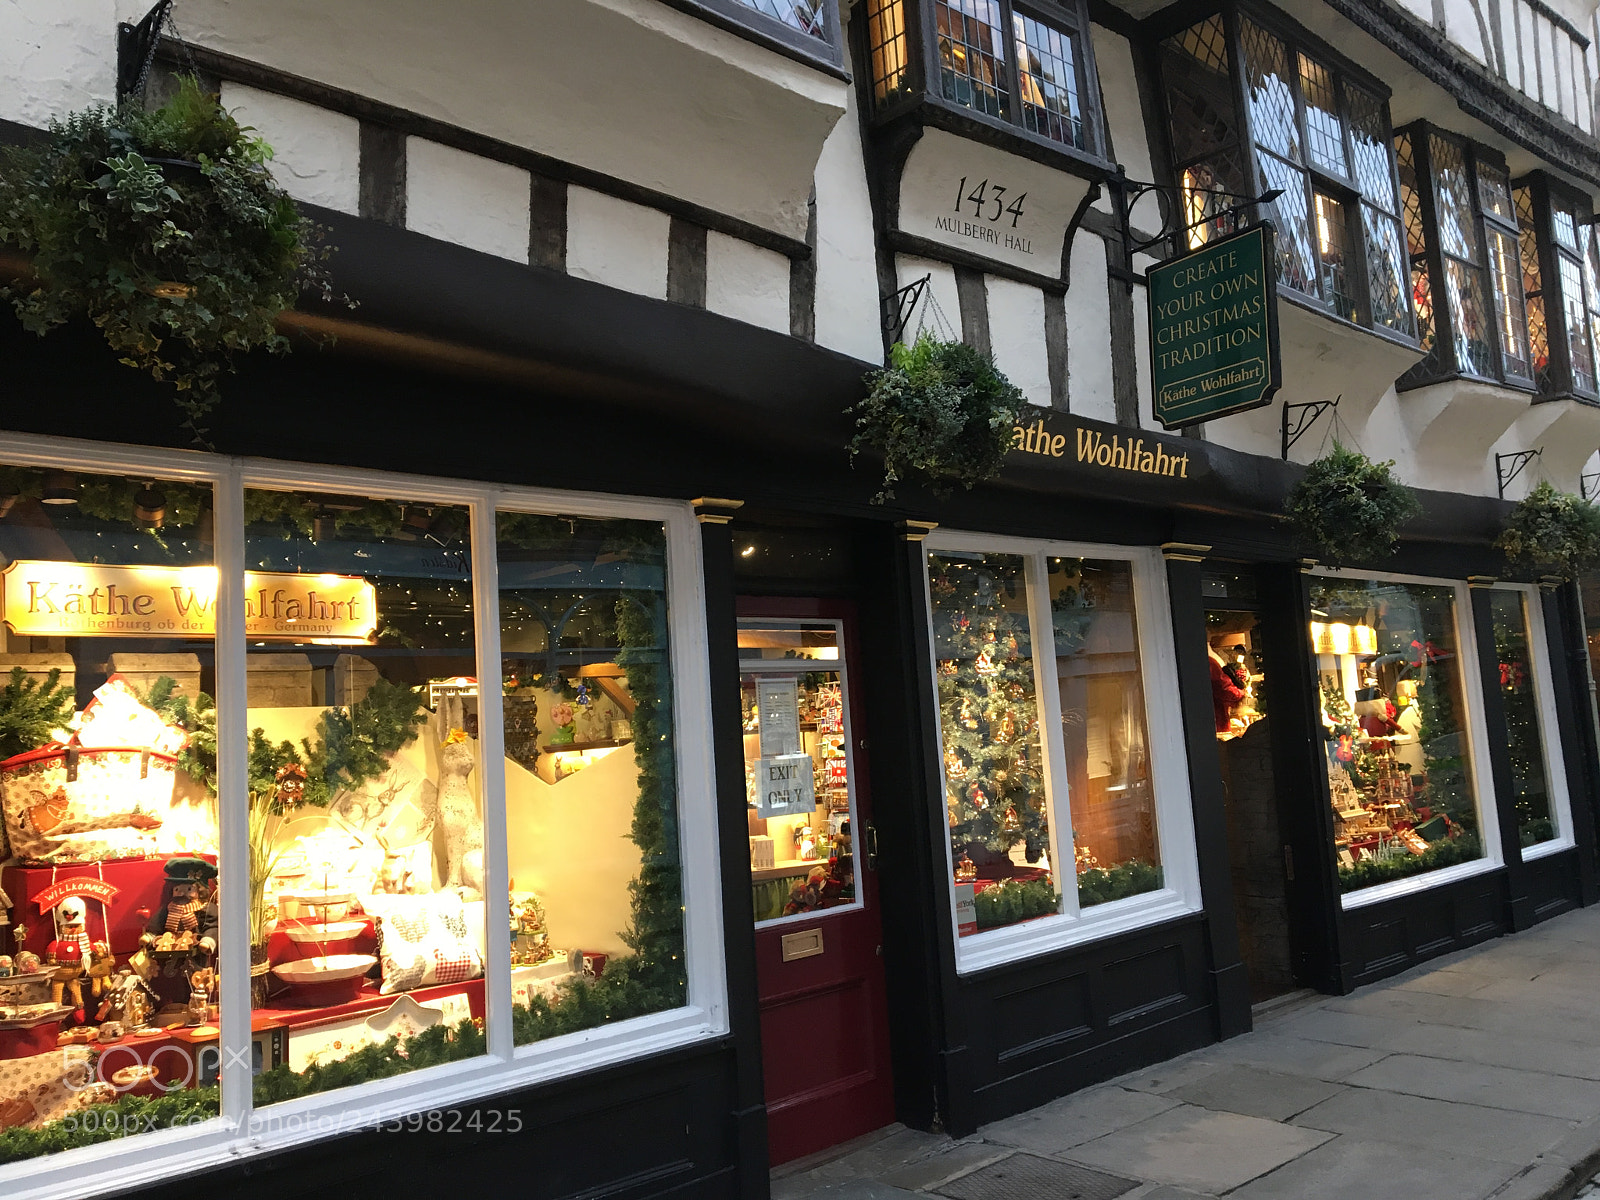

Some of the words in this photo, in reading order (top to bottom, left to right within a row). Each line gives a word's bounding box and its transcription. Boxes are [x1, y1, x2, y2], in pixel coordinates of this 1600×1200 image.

[955, 176, 1028, 228] 1434
[935, 216, 1001, 245] MULBERRY
[1005, 234, 1034, 254] HALL
[1173, 251, 1238, 289] CREATE
[1157, 290, 1206, 320] YOUR
[1210, 270, 1258, 300] OWN
[1157, 295, 1261, 345] CHRISTMAS
[1159, 323, 1261, 370] TRADITION
[1200, 365, 1260, 393] Wohlfahrt
[1005, 419, 1066, 458] äthe
[1076, 427, 1189, 479] Wohlfahrt
[27, 581, 156, 616] Käthe
[157, 620, 176, 630] ob
[181, 620, 205, 631] der
[274, 620, 333, 634] Germany
[769, 765, 798, 780] EXIT
[768, 788, 802, 805] ONLY
[44, 883, 110, 902] WILLKOMMEN
